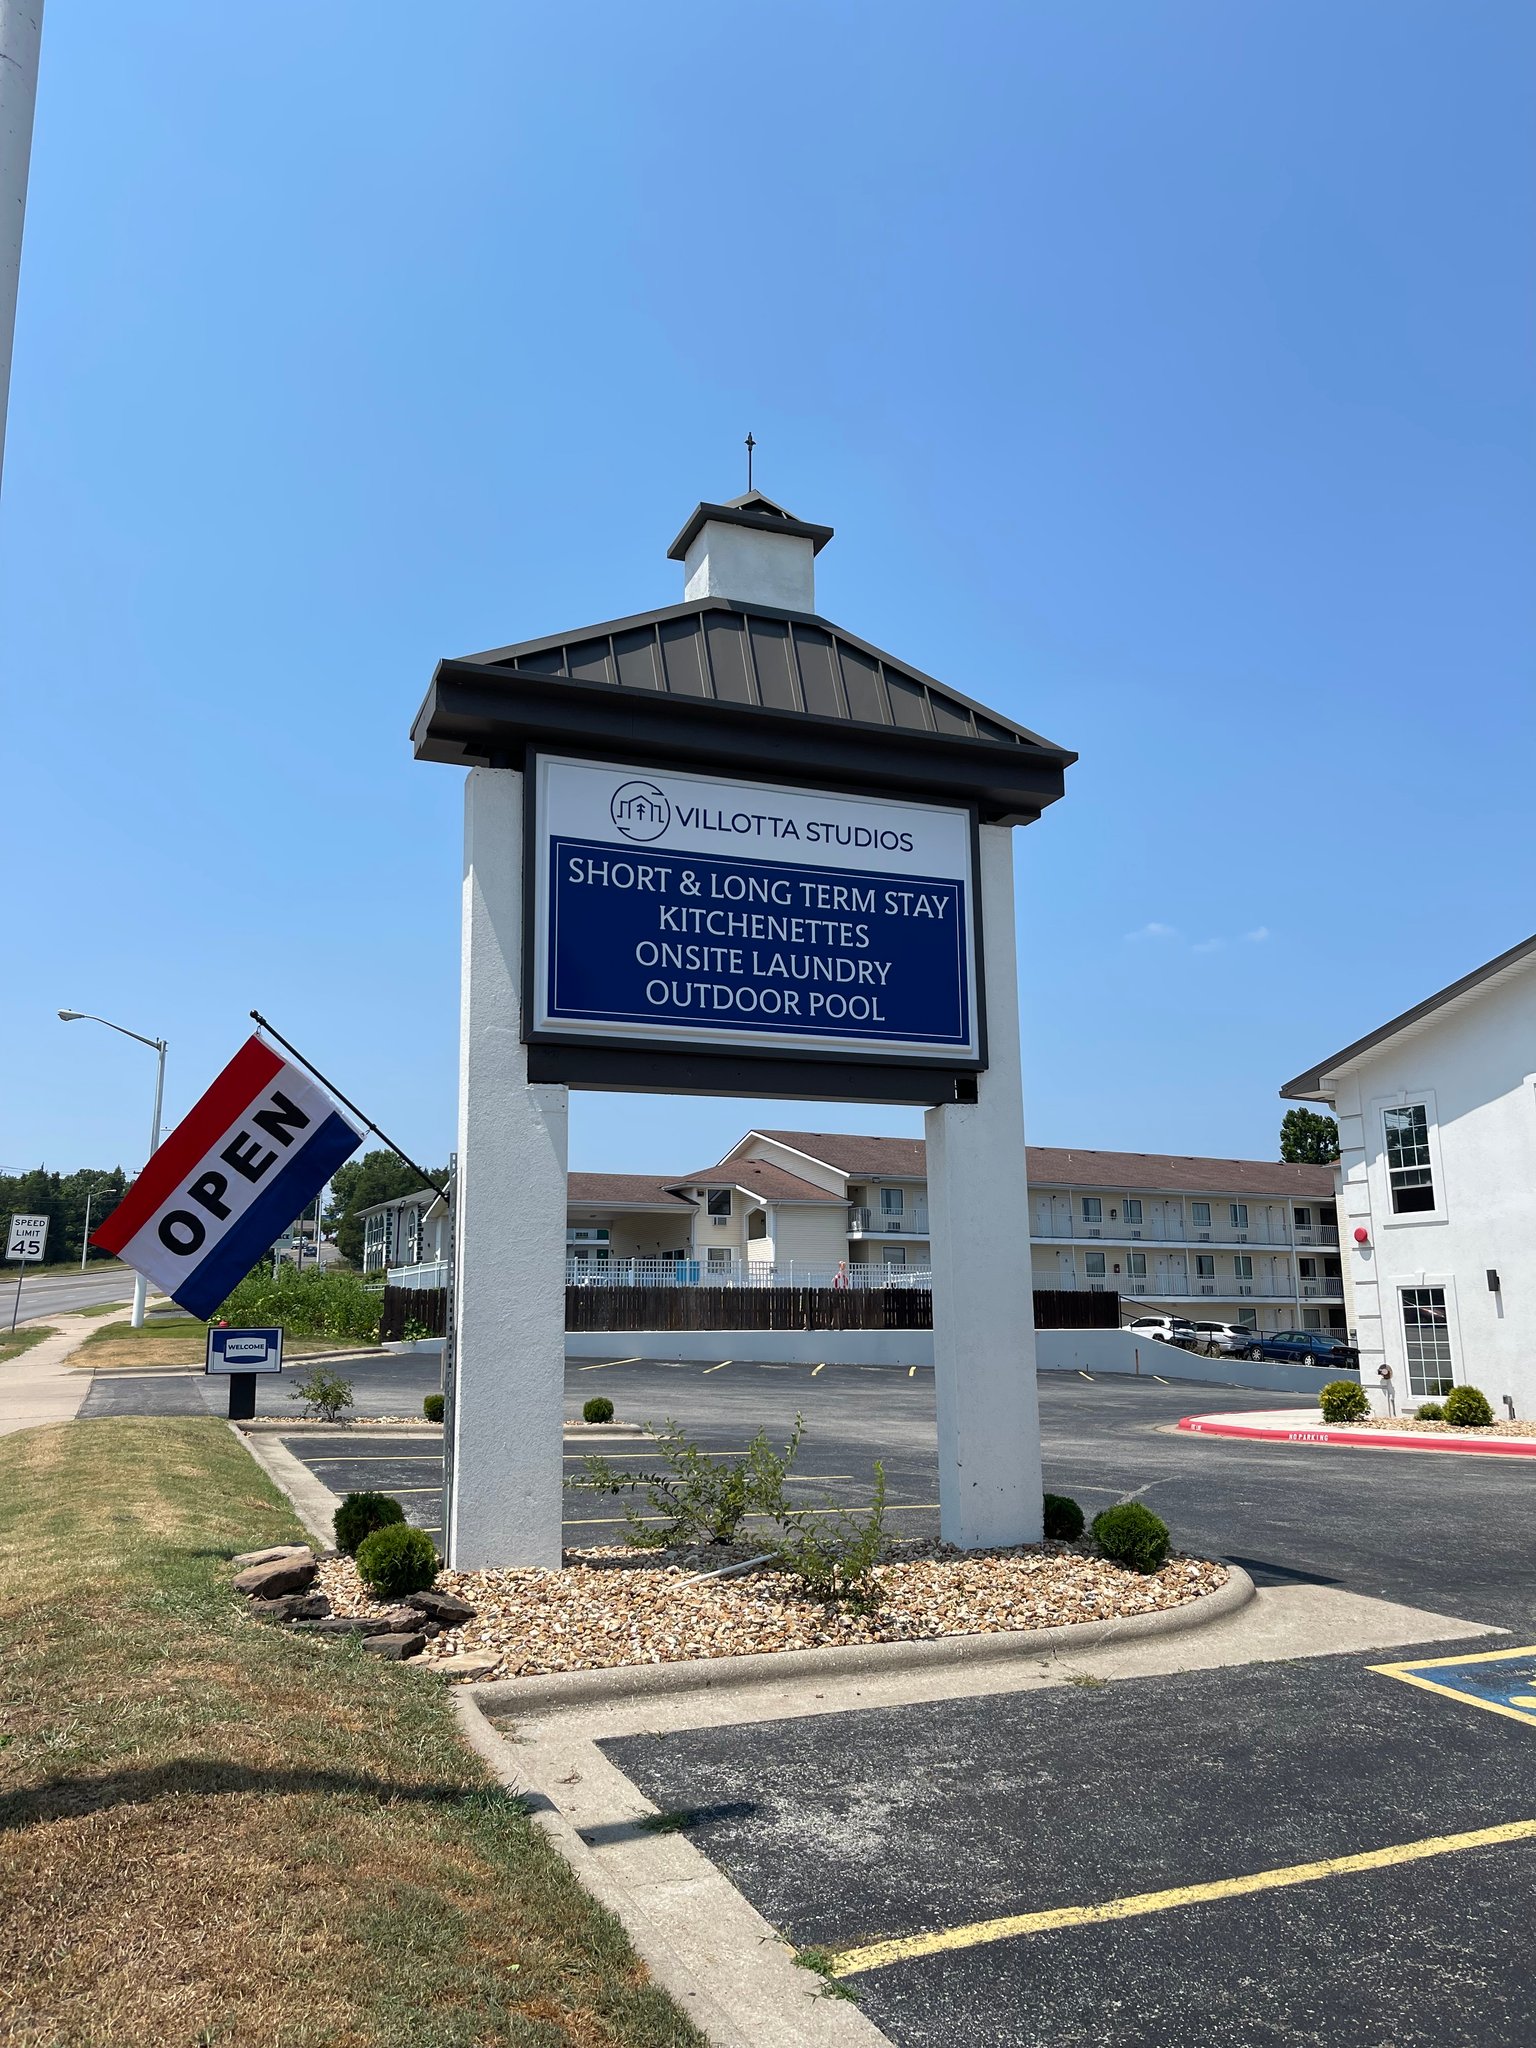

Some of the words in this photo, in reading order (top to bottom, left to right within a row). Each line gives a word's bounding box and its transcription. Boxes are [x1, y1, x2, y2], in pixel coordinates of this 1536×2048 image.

[675, 805, 800, 840] VILLOTTA
[806, 822, 914, 853] STUDIOS
[568, 857, 672, 893] SHORT
[679, 870, 702, 897] &
[710, 872, 792, 905] LONG
[799, 883, 877, 913] TERM
[884, 891, 949, 920] STAY
[659, 905, 870, 948] KITCHENETTES
[635, 941, 743, 974] ONSITE
[753, 951, 892, 986] LAUNDRY
[645, 979, 802, 1016] OUTDOOR
[809, 992, 885, 1022] POOL
[157, 1090, 311, 1257] OPEN
[15, 1219, 45, 1227] SPEED
[11, 1240, 40, 1255] 45
[1288, 1433, 1298, 1441] NO
[1298, 1433, 1329, 1442] PARKING
